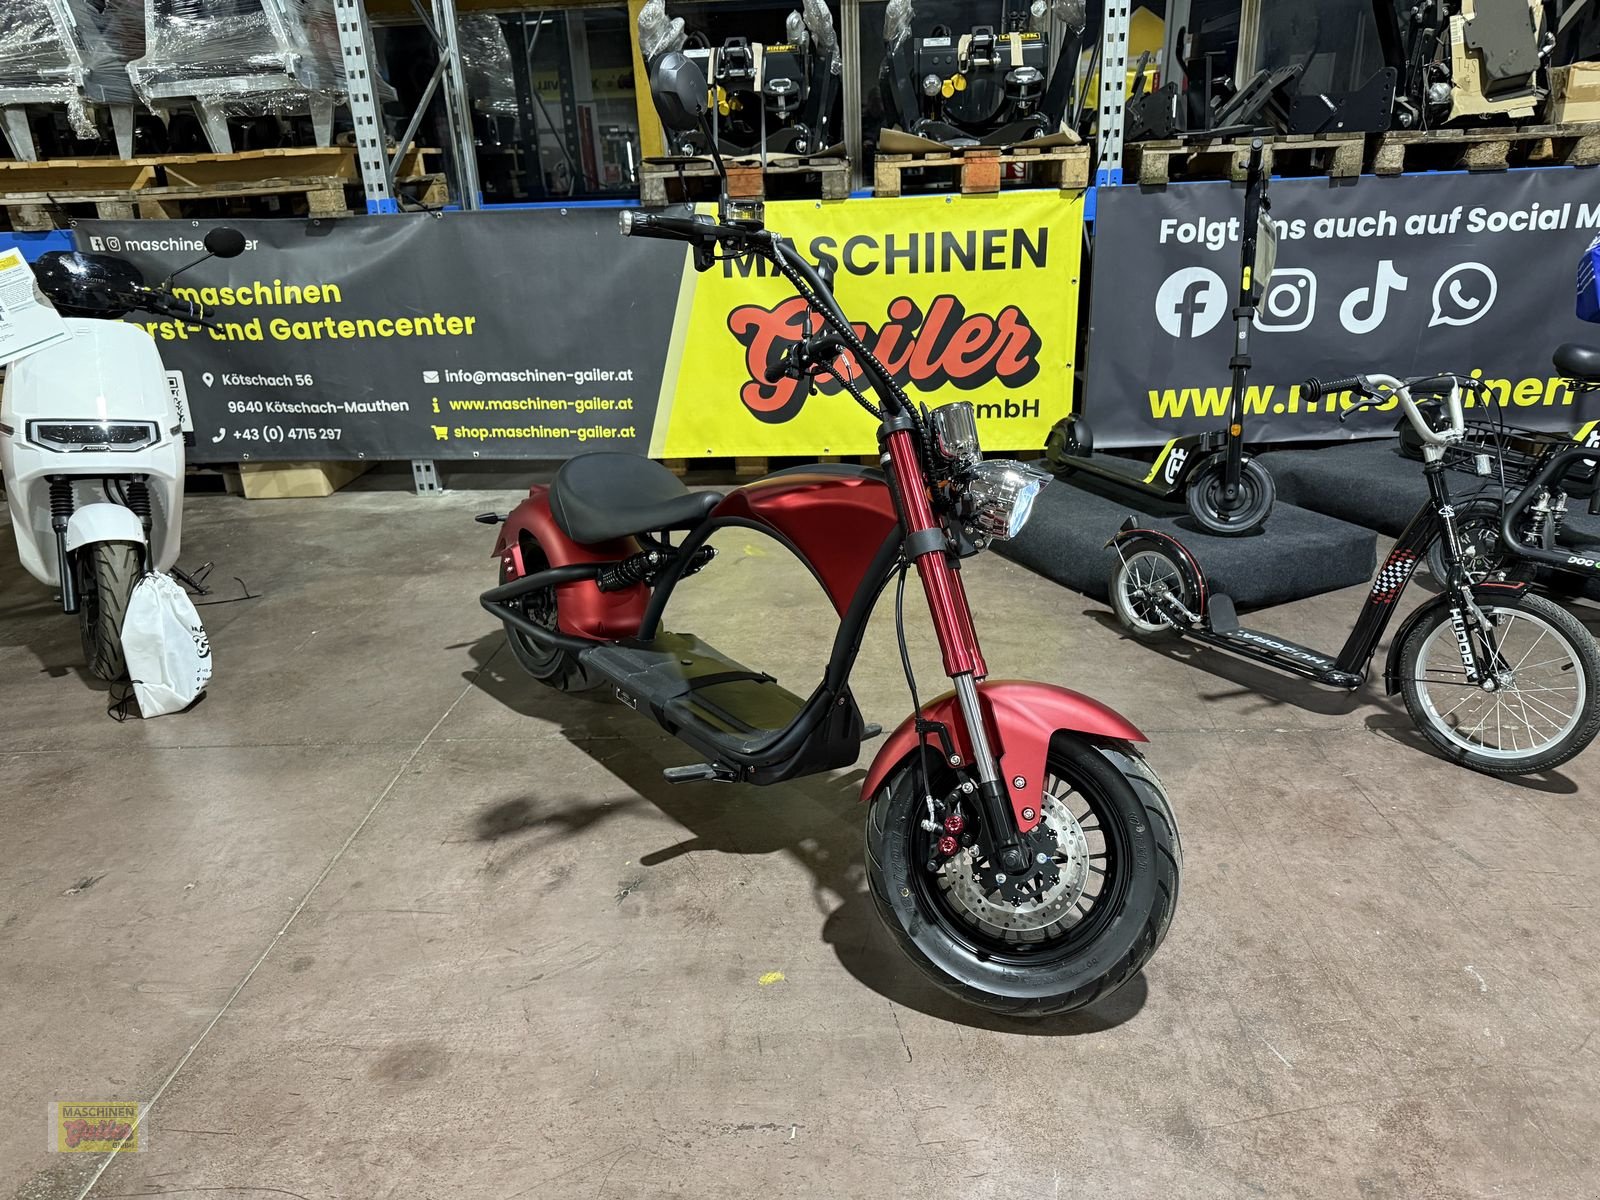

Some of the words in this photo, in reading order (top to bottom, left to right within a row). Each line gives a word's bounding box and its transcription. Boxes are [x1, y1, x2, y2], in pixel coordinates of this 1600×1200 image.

[1159, 216, 1240, 251] Folgt
[1273, 218, 1307, 240] ns
[1313, 210, 1398, 239] auch
[1404, 206, 1463, 236] auf
[1466, 202, 1572, 233] Social
[125, 237, 258, 251] maschineer
[143, 279, 342, 306] maschinen
[269, 312, 476, 341] Gartencenter
[222, 374, 293, 387] Kötschach
[295, 374, 314, 386] 56
[444, 369, 634, 384] info@maschinen-gailer.at
[228, 401, 263, 413] 9640
[265, 400, 410, 414] Kötschach-Mauthen
[449, 397, 634, 414] www.maschinen-gailer.at
[976, 399, 1040, 418] mbH
[233, 428, 259, 440] +43
[263, 425, 284, 442] (0)
[287, 428, 317, 440] 4715
[319, 428, 342, 440] 297
[454, 425, 636, 441] shop.maschinen-gailer.at
[1449, 607, 1478, 679] HUDORA
